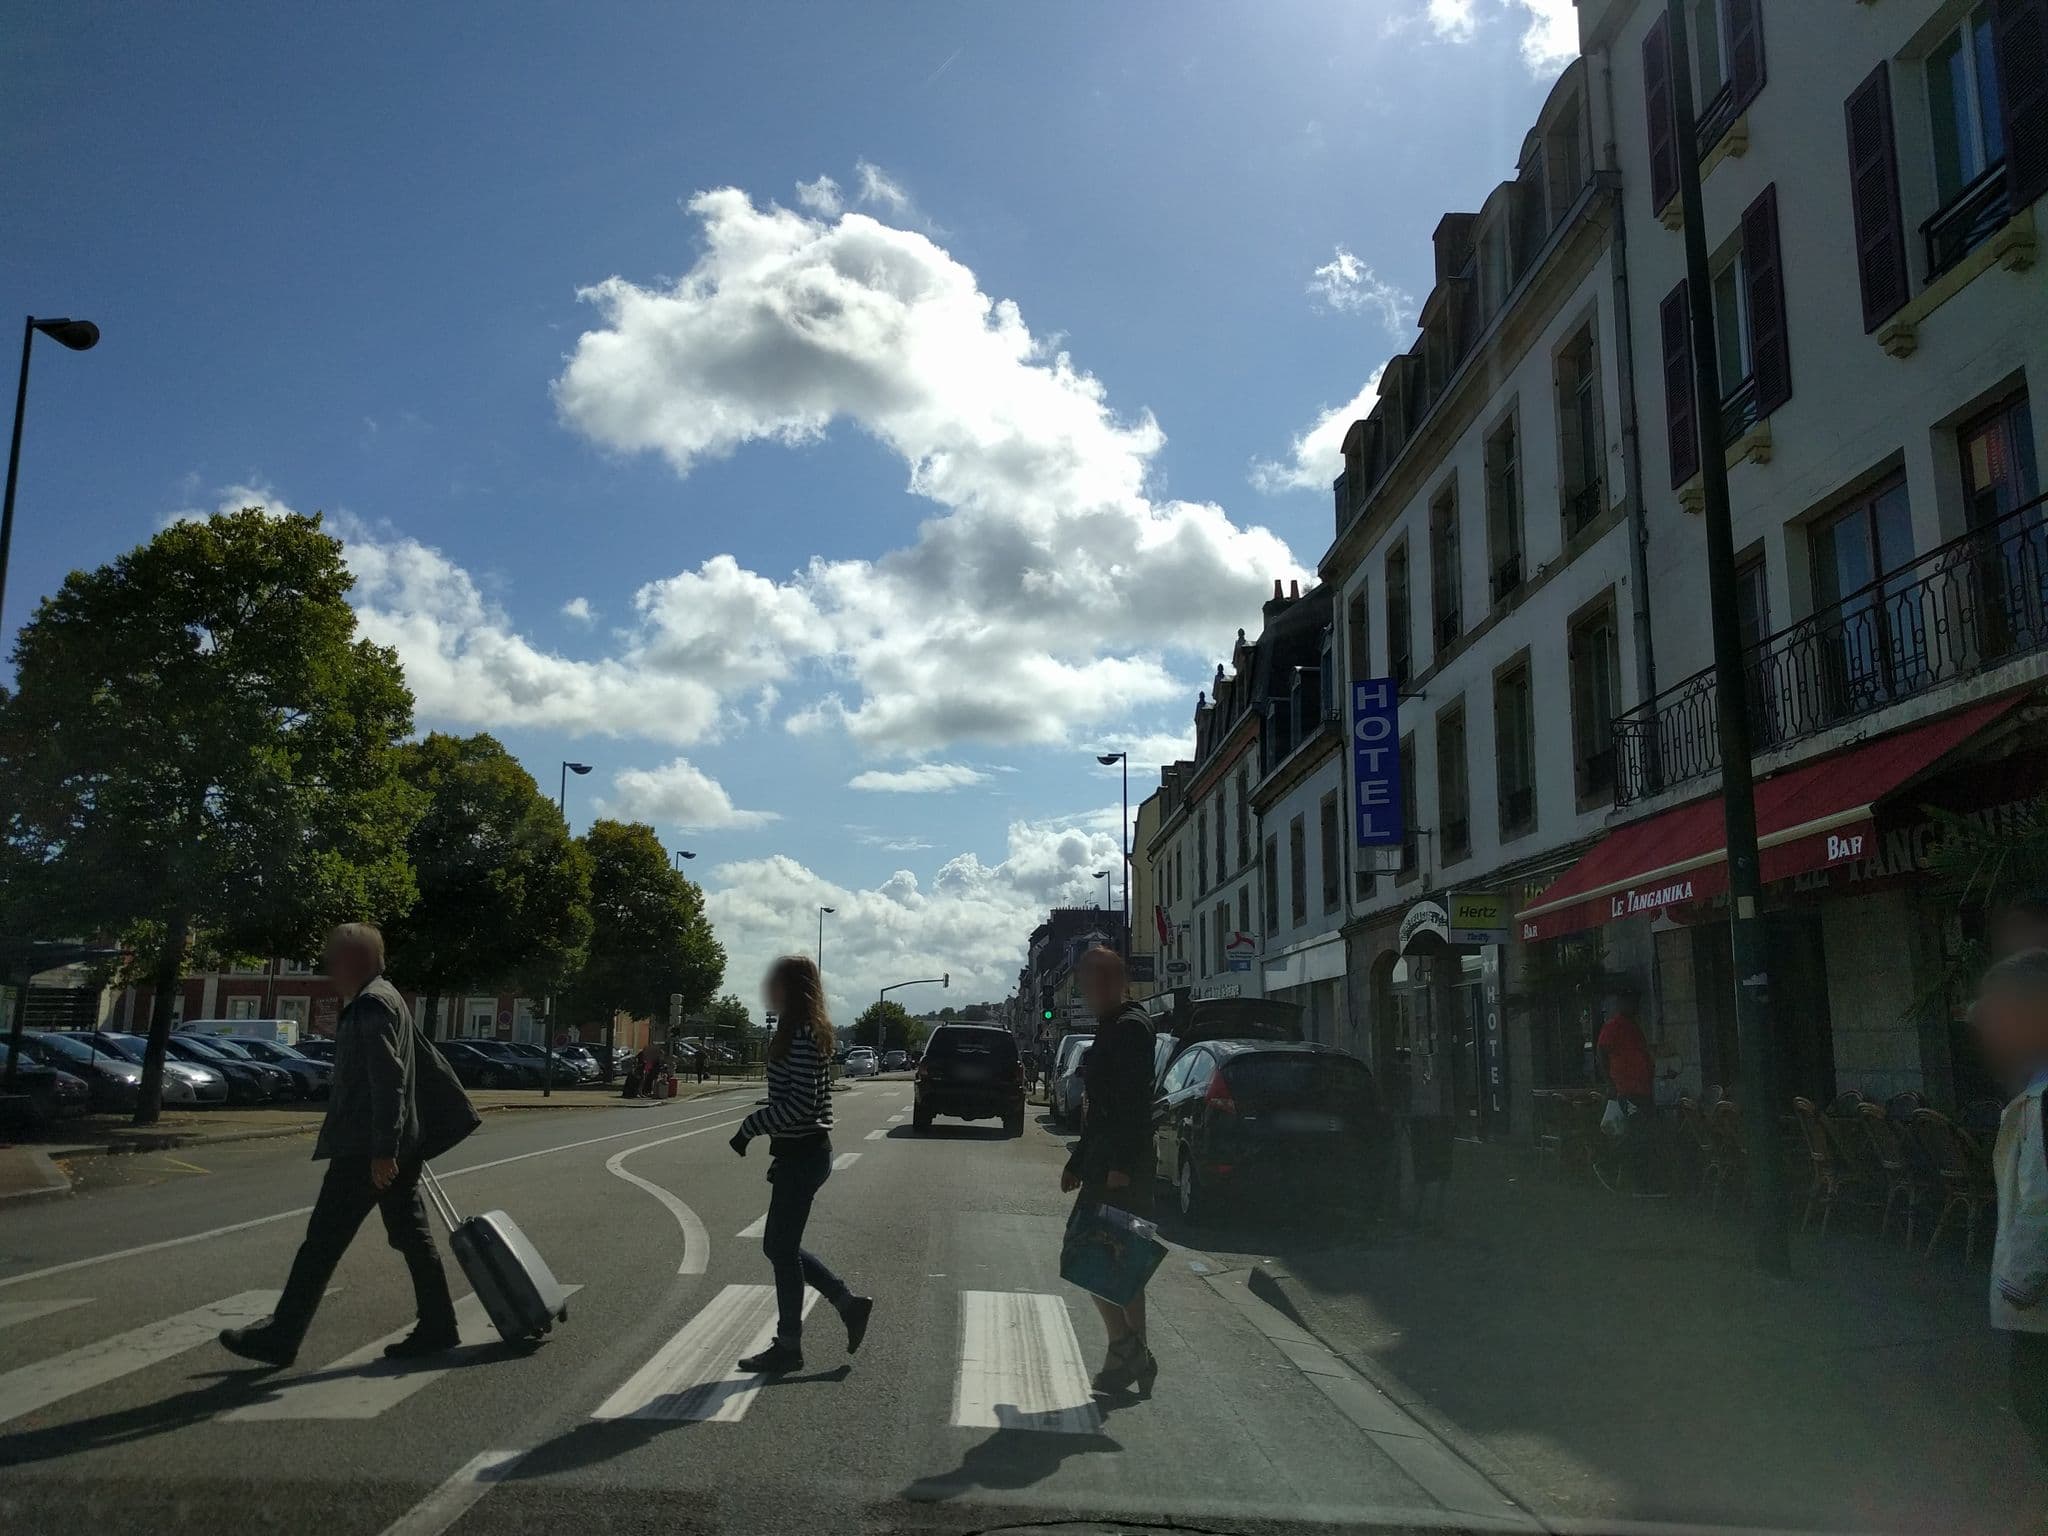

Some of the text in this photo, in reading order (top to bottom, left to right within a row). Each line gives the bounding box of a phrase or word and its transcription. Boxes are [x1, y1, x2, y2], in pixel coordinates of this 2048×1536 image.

[1354, 683, 1392, 838] HOTEL
[1458, 905, 1497, 918] Hertz
[1626, 881, 1695, 913] TANGANIKA
[1487, 986, 1501, 1112] HOTEL
